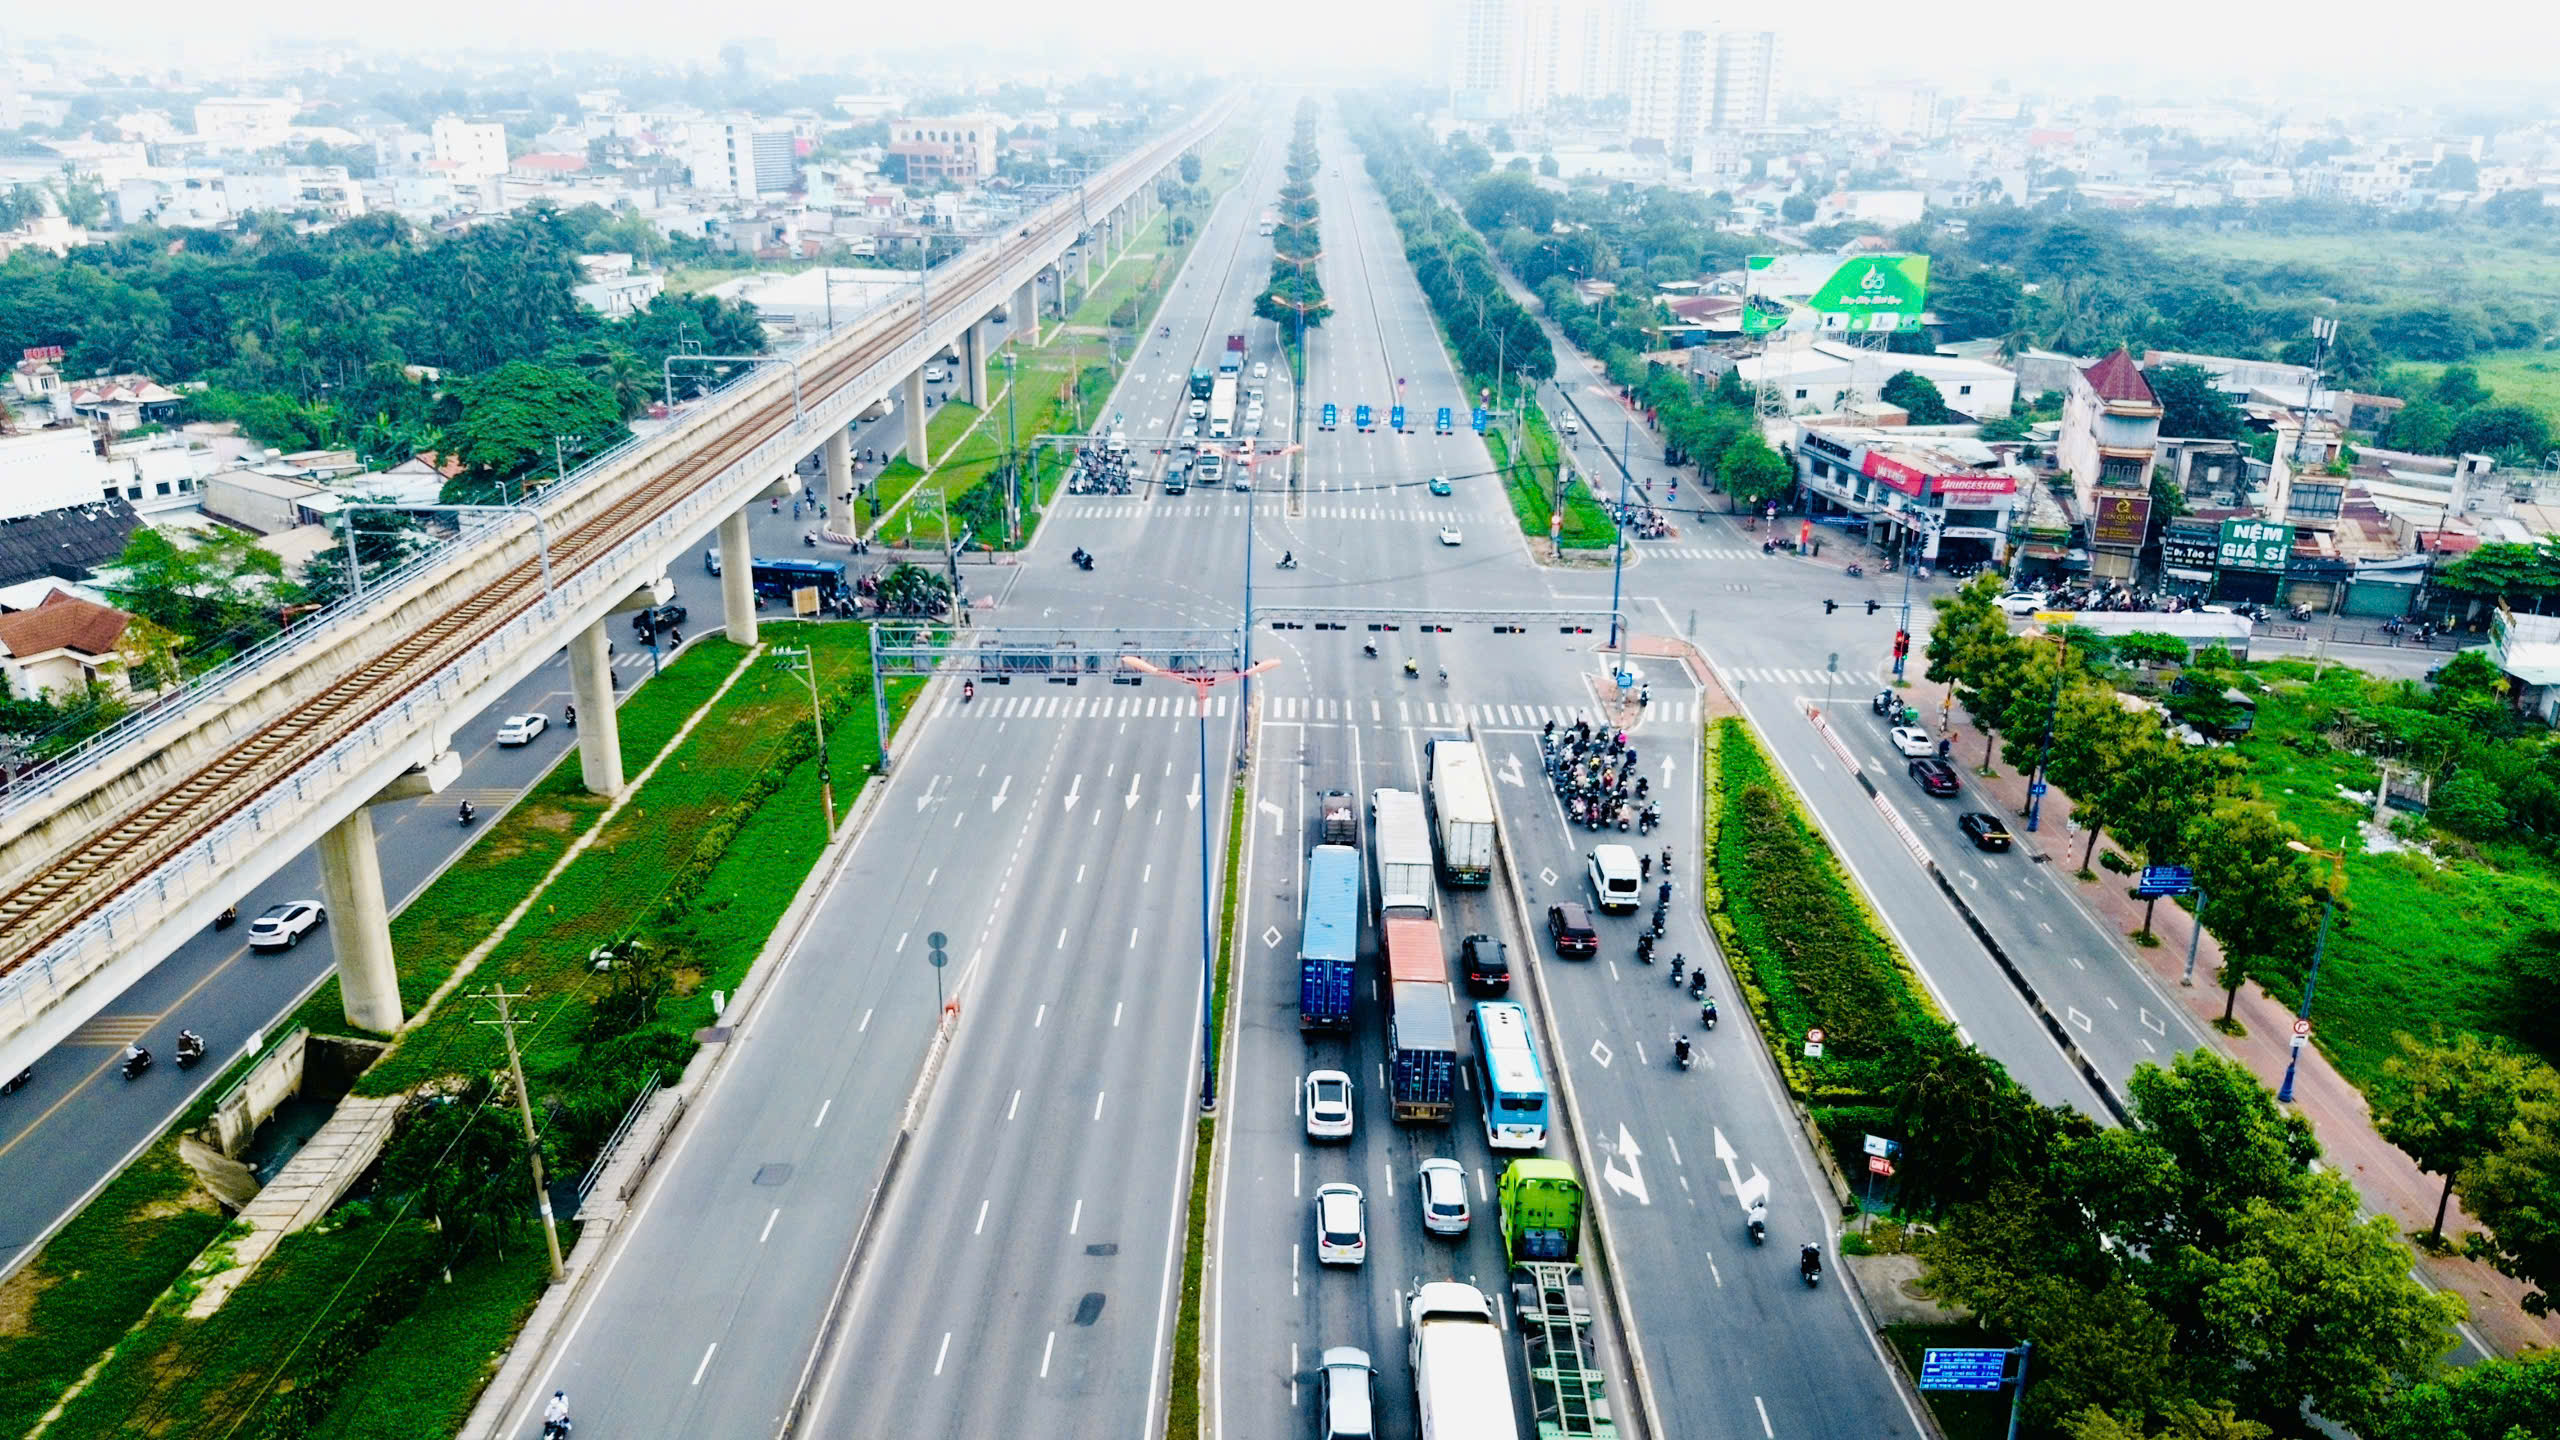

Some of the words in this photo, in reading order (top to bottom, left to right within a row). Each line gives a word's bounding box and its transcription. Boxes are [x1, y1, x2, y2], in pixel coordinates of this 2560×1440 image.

[1941, 480, 2006, 490] BRIDGESTONE
[2233, 523, 2284, 542] NỆM
[2222, 543, 2257, 559] GIÁ
